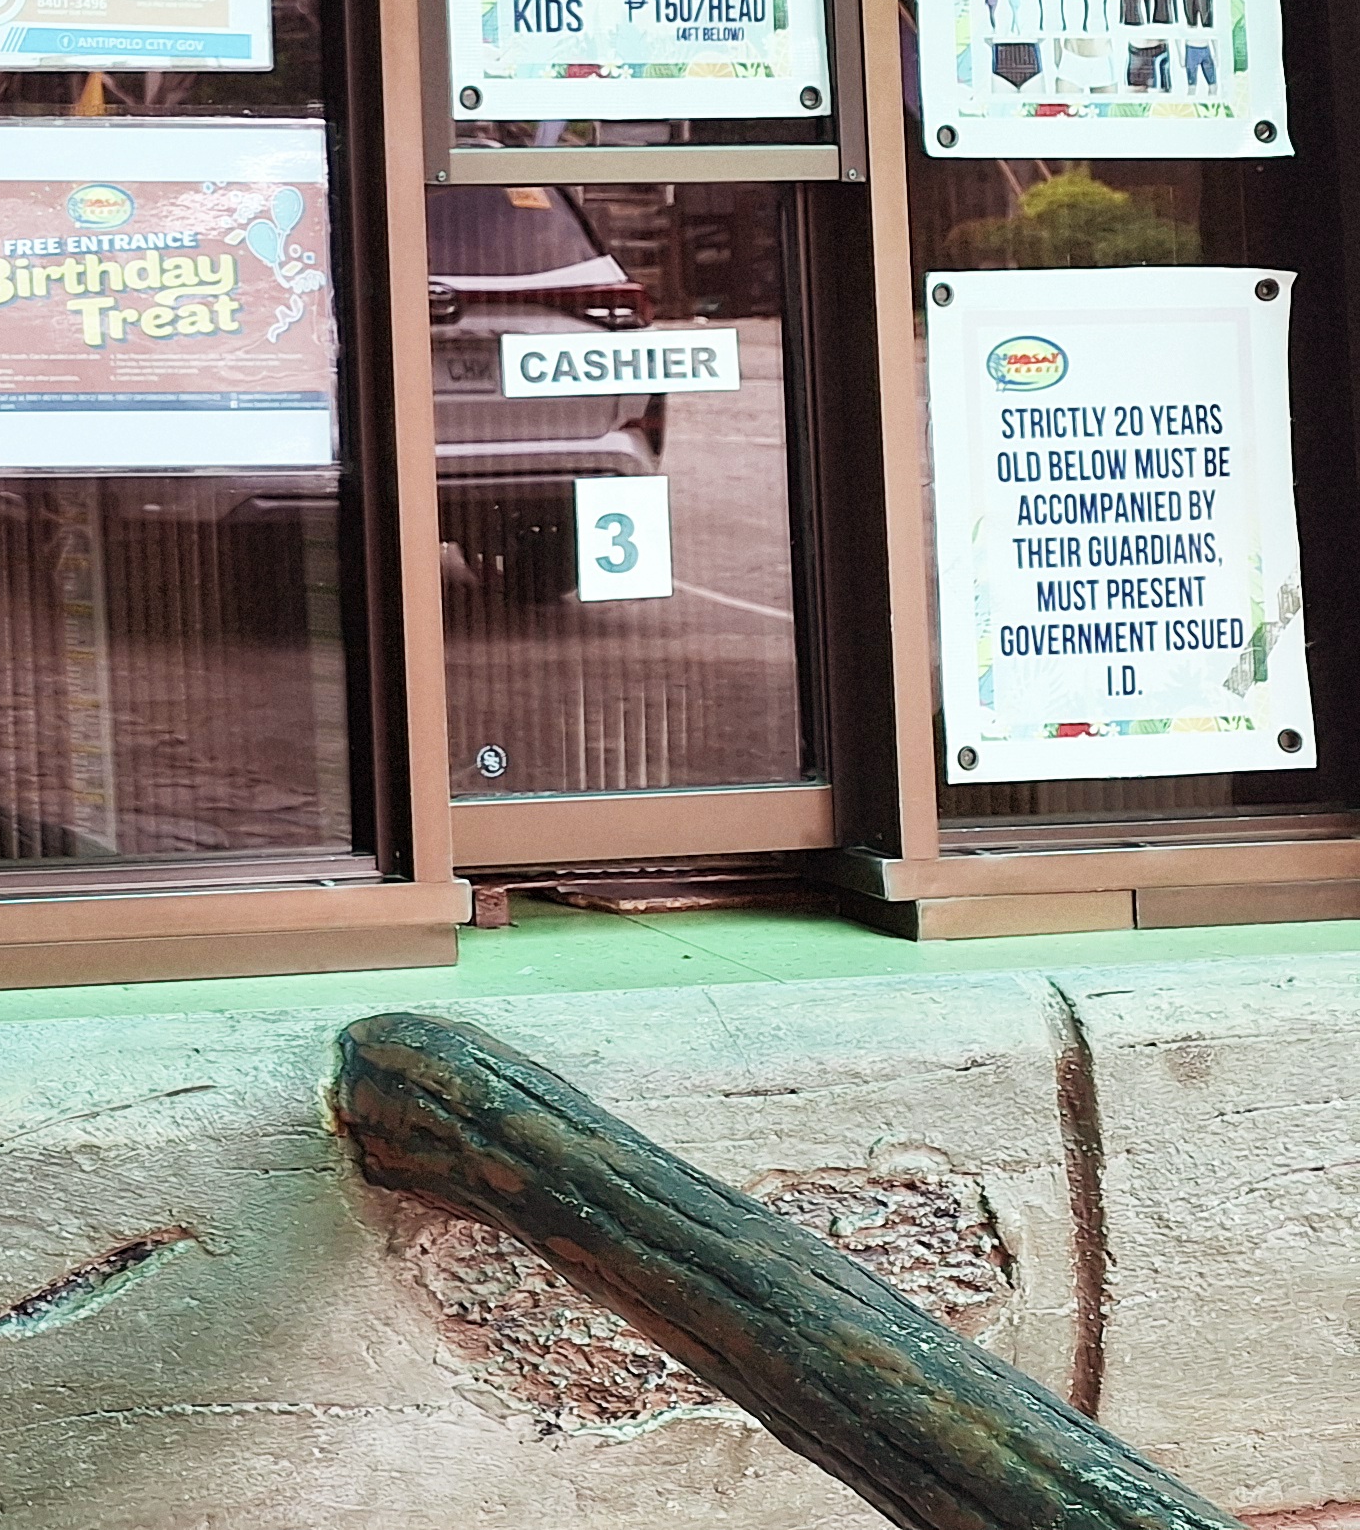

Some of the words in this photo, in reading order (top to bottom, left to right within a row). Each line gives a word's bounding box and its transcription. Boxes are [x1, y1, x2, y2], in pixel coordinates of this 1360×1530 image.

[77, 36, 141, 50] ANTIPOLO
[145, 37, 173, 51] CITY
[176, 38, 204, 51] GOV
[676, 27, 700, 41] (4FT
[703, 27, 745, 41] BELOW)
[4, 237, 62, 255] FREE
[66, 232, 197, 254] ENTRANCE
[67, 296, 241, 348] Treat
[520, 347, 718, 383] CASHIER
[1001, 406, 1106, 439] STRICTLY
[1113, 406, 1144, 436] 20
[1150, 404, 1224, 436] YEARS
[997, 451, 1041, 483] OLD
[1050, 449, 1127, 482] BELOW
[1135, 448, 1197, 480] MUST
[1204, 447, 1230, 477] BE
[1017, 491, 1181, 526] ACCOMPANIED
[1190, 490, 1216, 520] BY
[595, 513, 638, 573] 3
[1013, 538, 1081, 568] THEIR
[1088, 533, 1224, 568] GUARDIANS,
[1036, 579, 1100, 612] MUST
[1107, 576, 1206, 610] PRESENT
[1000, 621, 1157, 657] GOVERNMENT
[1165, 618, 1244, 651] ISSUED
[1107, 666, 1143, 697] I.D.
